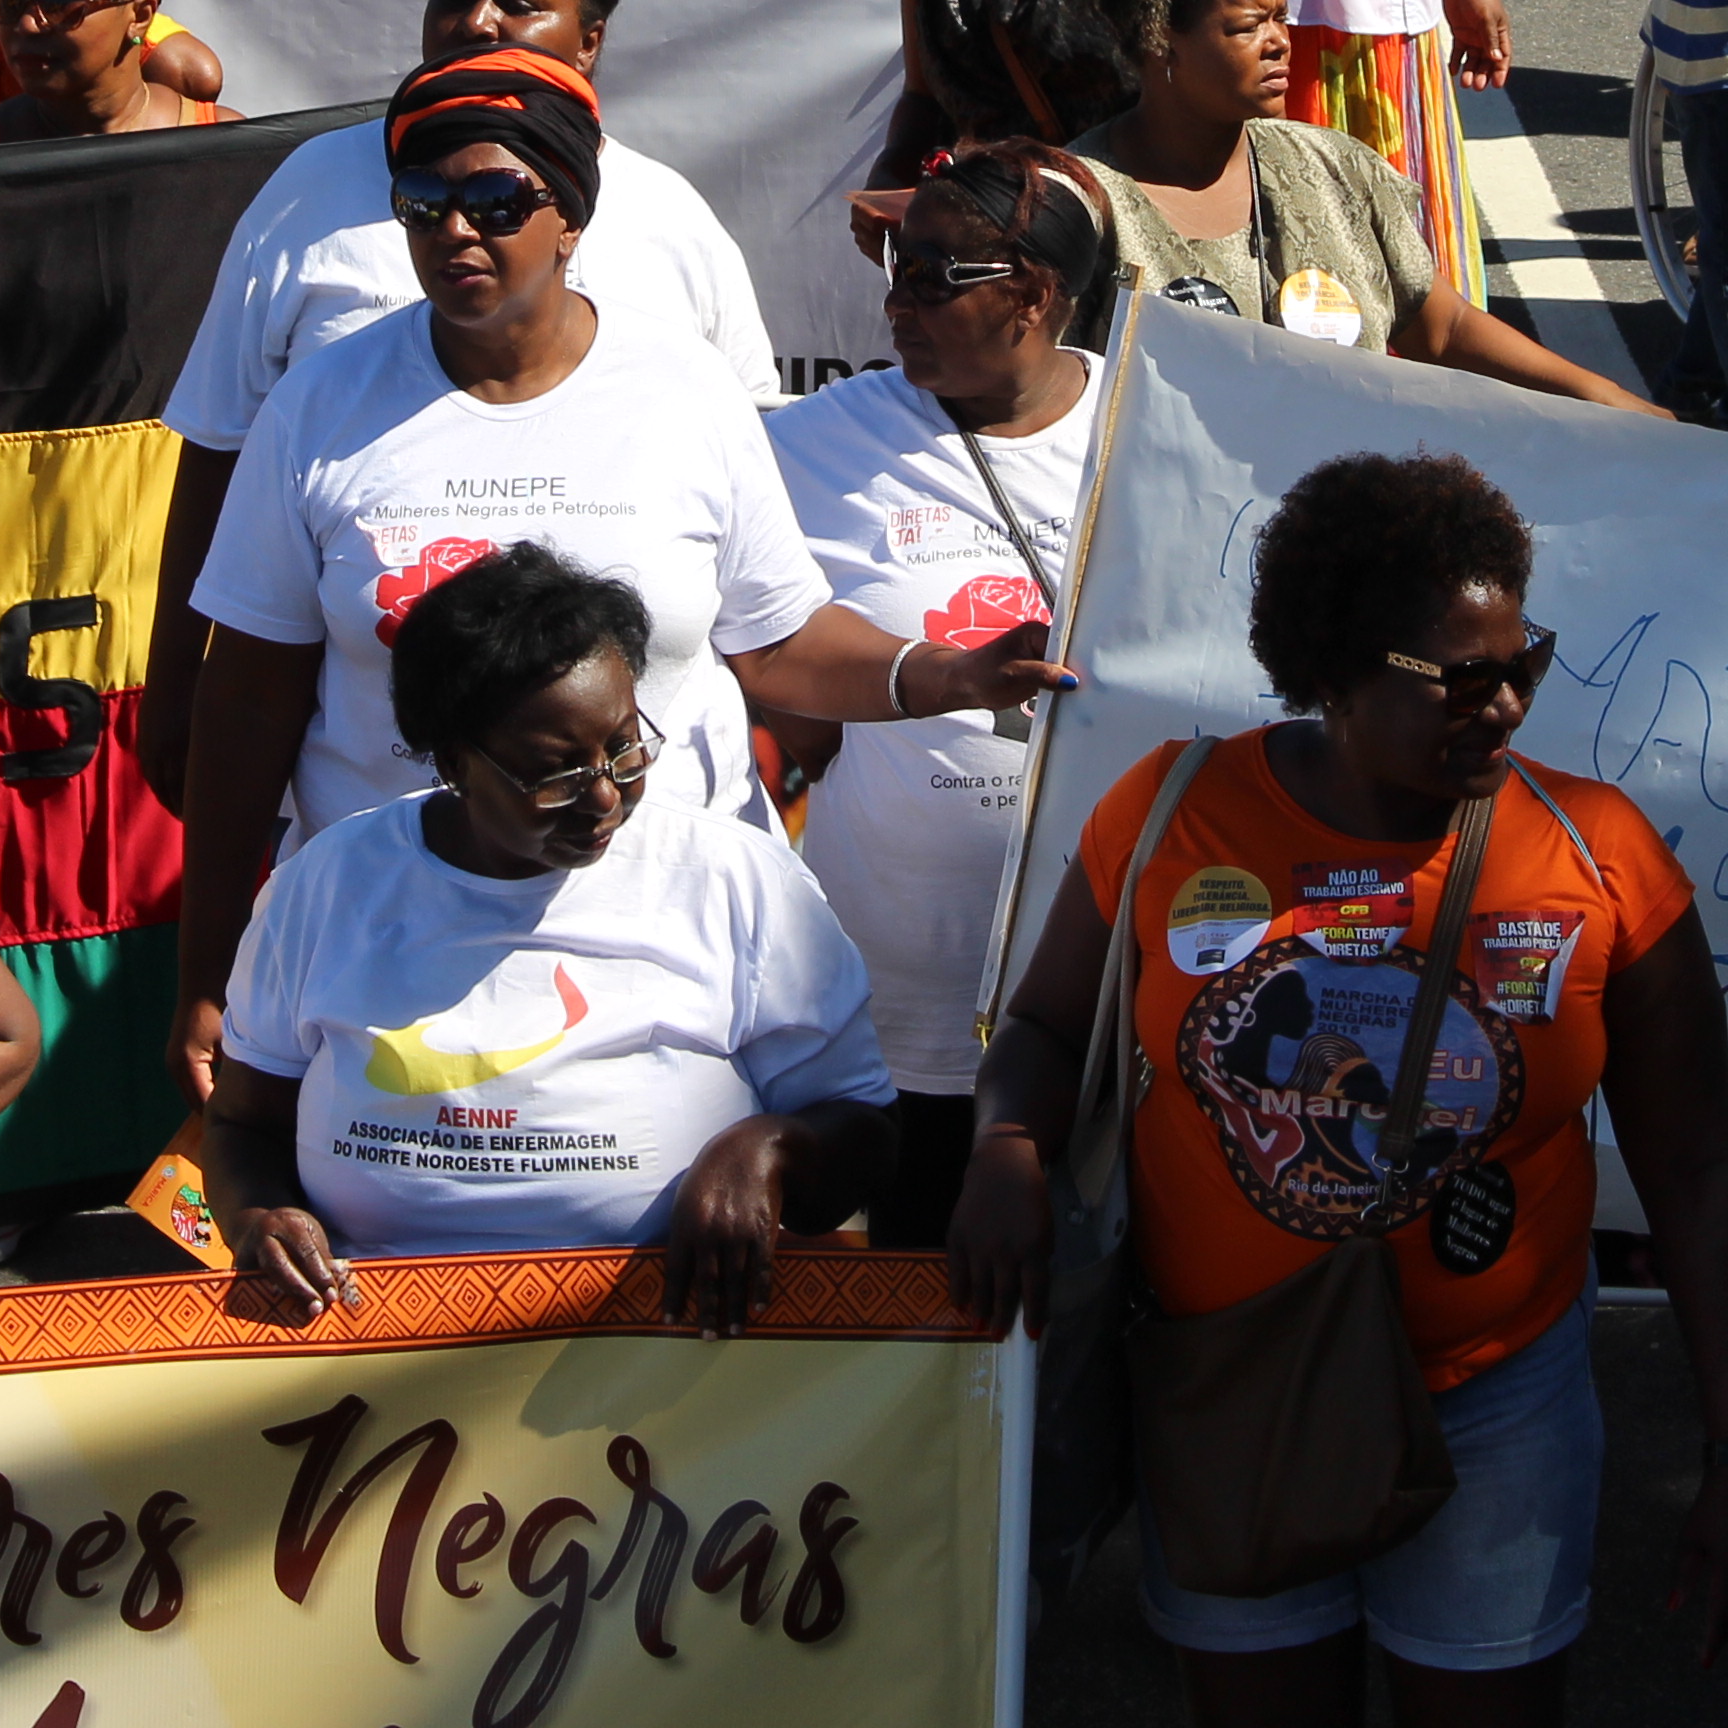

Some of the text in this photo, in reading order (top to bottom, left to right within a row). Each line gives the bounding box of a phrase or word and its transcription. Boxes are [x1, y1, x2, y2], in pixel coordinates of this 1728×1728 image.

[445, 477, 567, 499] MUNEPE
[374, 500, 637, 520] Mulheres Negras de Petrópolis
[891, 506, 952, 527] DIRETAS
[374, 524, 420, 545] RETAS
[906, 547, 983, 567] Mulheres
[931, 773, 1002, 789] Contra o
[980, 795, 991, 807] e
[1328, 868, 1379, 887] NÃO AO
[1304, 881, 1405, 898] TRABALHO ESCRAVO
[1498, 921, 1562, 938] BASTA DE
[1483, 938, 1533, 950] TRABALHO
[1321, 987, 1403, 1007] MARCHA
[1318, 1010, 1397, 1029] NEGRAS
[435, 1105, 519, 1130] AENNF
[348, 1120, 618, 1152] ASSOCIAÇÃO DE ENFERMAGEM
[333, 1139, 640, 1173] DO NORTE NOROESTE FLUMINENSE
[1287, 1177, 1308, 1194] Rio
[1312, 1179, 1327, 1194] de
[261, 1392, 861, 1728] Negras
